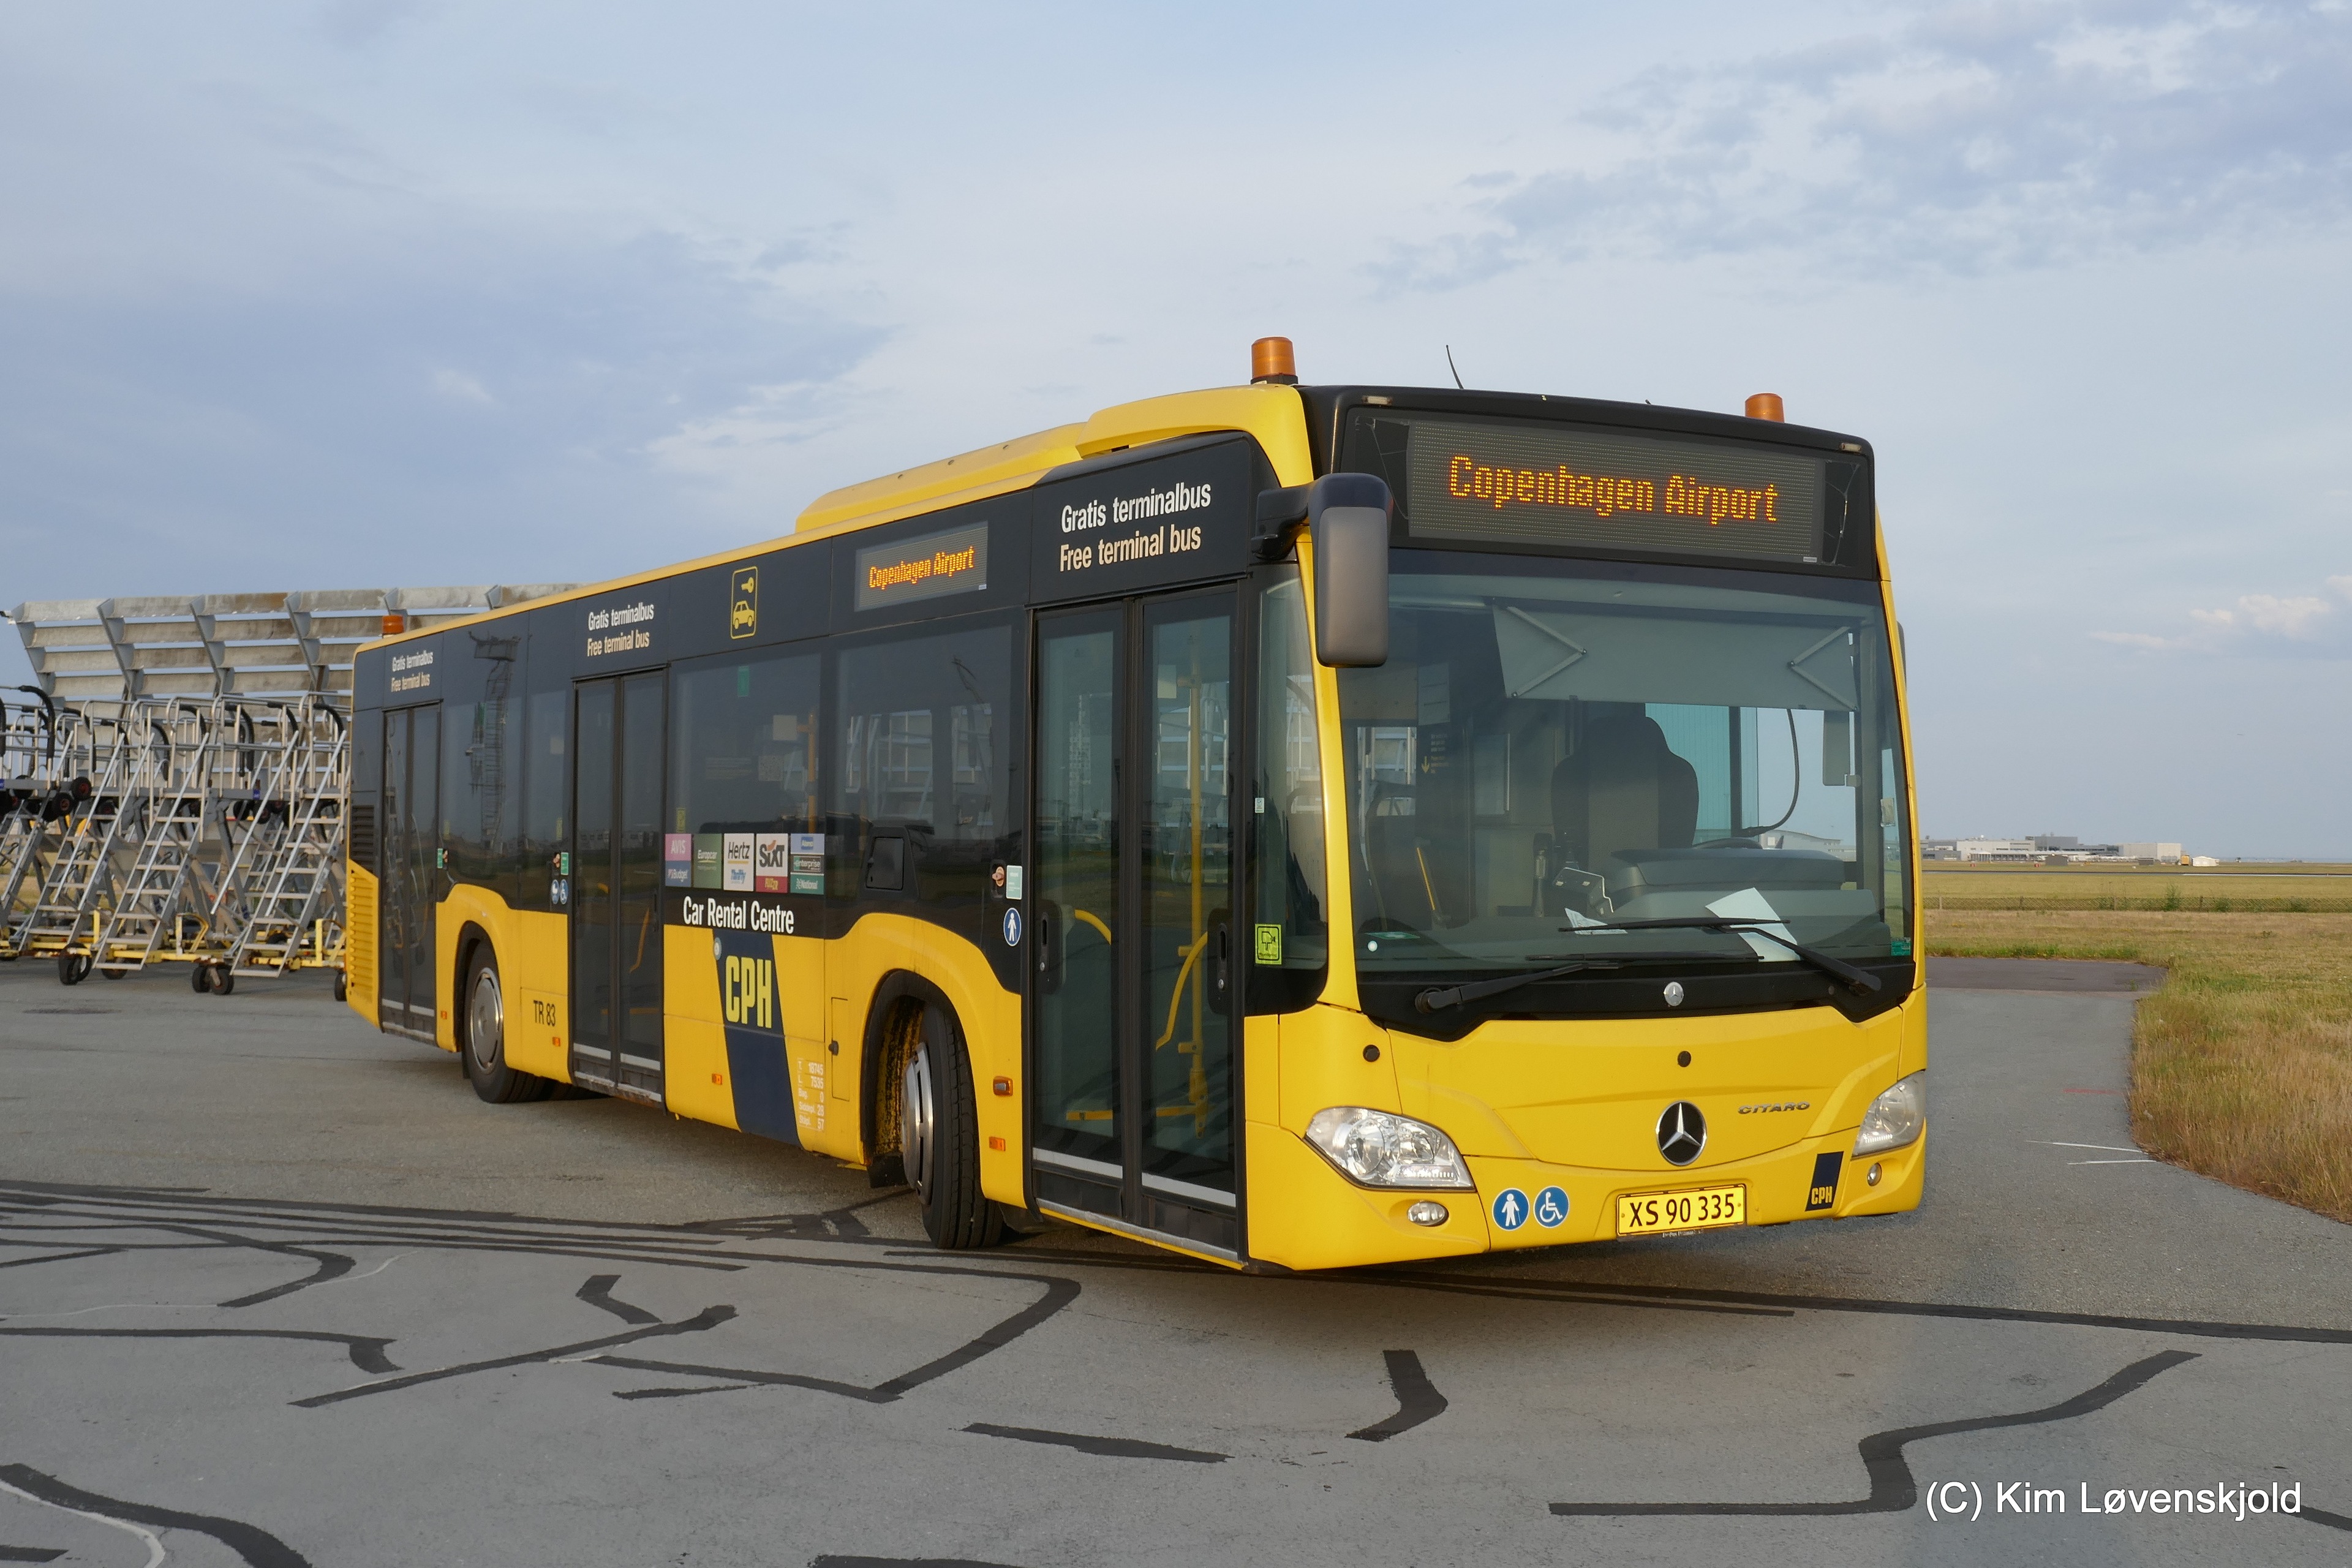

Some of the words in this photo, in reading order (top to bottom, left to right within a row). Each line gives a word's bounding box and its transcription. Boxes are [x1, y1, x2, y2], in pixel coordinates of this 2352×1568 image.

[1449, 456, 1653, 516] Copenhagen
[1665, 475, 1778, 526] Airport
[1061, 503, 1106, 533] Gratis
[1112, 483, 1212, 524] terminalbus
[1059, 543, 1092, 572] Free
[1098, 525, 1164, 564] terminal
[1170, 524, 1201, 554] bus
[869, 560, 931, 590] Copenhagen
[933, 546, 974, 577] Airport
[588, 609, 609, 631] Gratis
[611, 602, 655, 627] terminalbus
[587, 638, 602, 657] Free
[604, 630, 634, 654] terminal
[635, 630, 650, 649] bus
[392, 657, 405, 672] Gratis
[406, 650, 434, 669] terminalbus
[391, 677, 401, 692] Free
[401, 672, 420, 690] terminal
[420, 672, 430, 687] bus
[671, 840, 686, 854] AVIS
[698, 850, 718, 860] Europcar
[728, 842, 751, 860] Hertz
[683, 895, 704, 925] Car
[707, 897, 747, 930] Rental
[750, 900, 794, 934] Centre
[725, 955, 772, 1029] CPH
[533, 1000, 545, 1025] TR
[546, 1003, 556, 1027] 83
[1738, 1101, 1811, 1114] CITARO
[1811, 1186, 1833, 1205] CPH
[1629, 1200, 1659, 1227] XS
[1666, 1197, 1691, 1225] 90
[1698, 1193, 1735, 1221] 335
